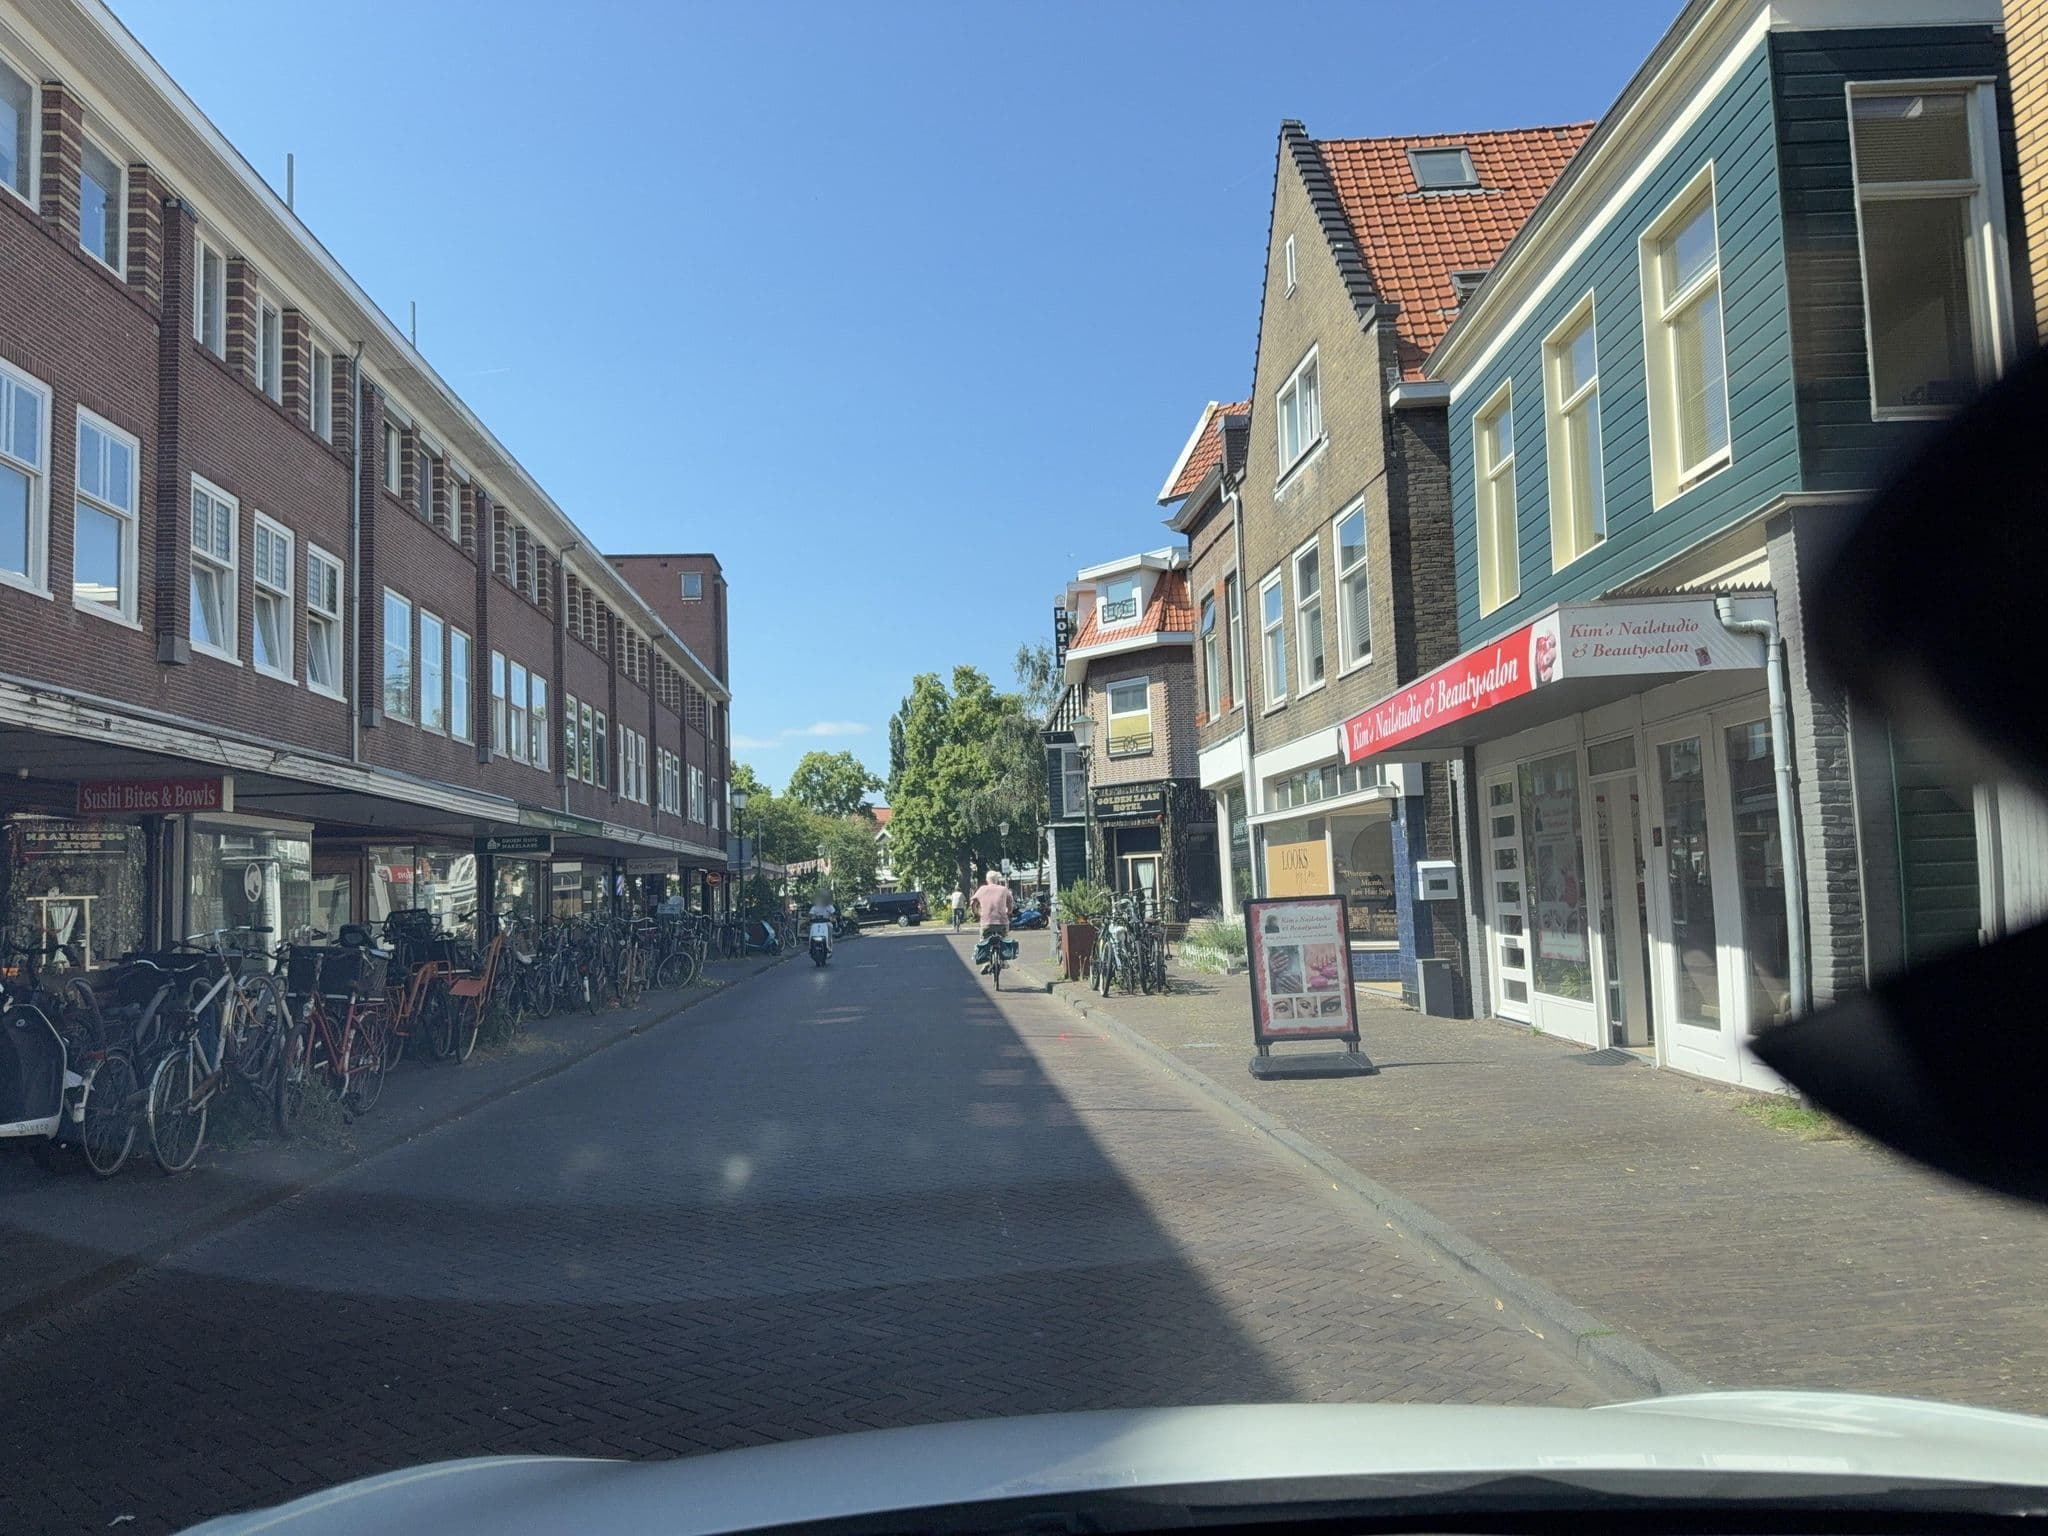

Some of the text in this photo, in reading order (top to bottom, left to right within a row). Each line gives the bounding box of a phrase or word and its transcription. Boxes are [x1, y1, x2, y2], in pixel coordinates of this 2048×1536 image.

[1570, 617, 1699, 638] Kim's Nailstudio
[1572, 638, 1689, 659] & Beautysalon
[1352, 647, 1518, 751] Kim's Nailstudio & Beautysalon
[83, 783, 216, 809] Sushi Bites & Bowls
[1096, 792, 1161, 806] GOLDEN ZAAN
[1112, 802, 1143, 812] HOTEL
[1281, 847, 1309, 871] LOOKS
